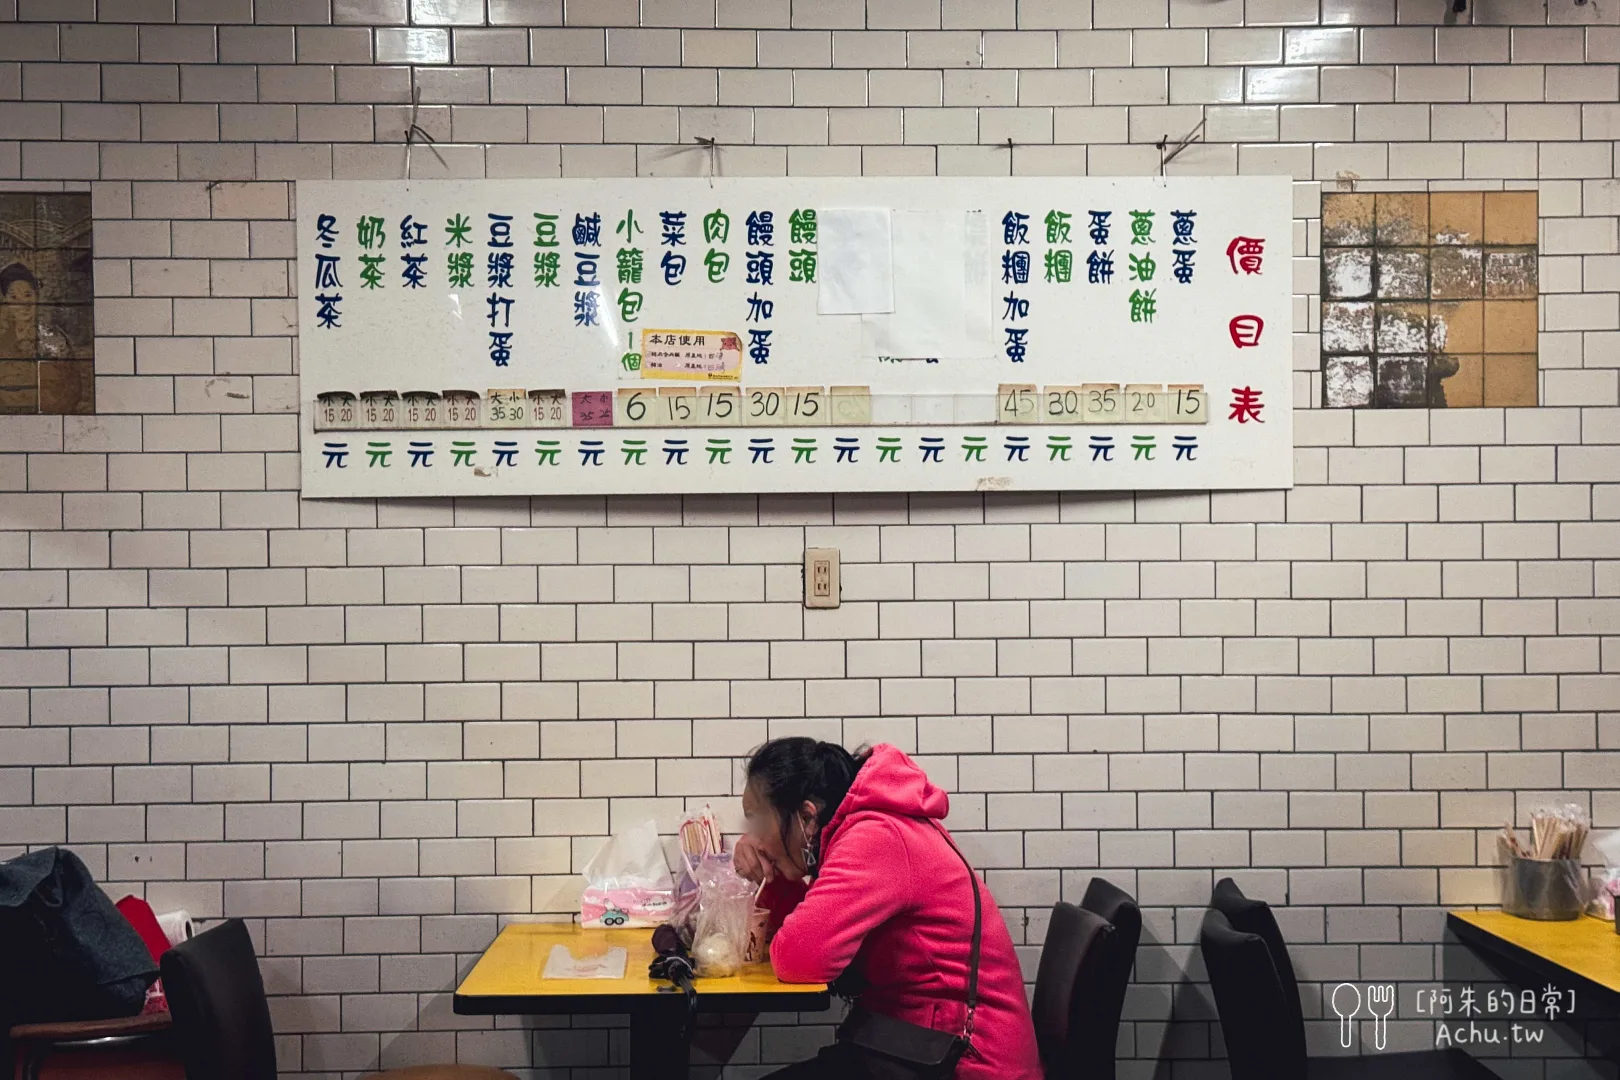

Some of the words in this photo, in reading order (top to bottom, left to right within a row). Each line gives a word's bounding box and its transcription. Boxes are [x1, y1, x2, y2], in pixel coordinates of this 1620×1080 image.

[357, 215, 385, 290] 奶茶
[400, 215, 428, 289] 紅茶
[445, 213, 474, 288] 米漿
[534, 213, 560, 287] 豆漿
[659, 211, 686, 285] 菜包
[704, 209, 729, 283] 肉包
[789, 209, 817, 283] 饅頭
[1045, 210, 1072, 282] 飯糰
[1087, 211, 1114, 284] 蛋餅
[1171, 210, 1197, 283] 蔥蛋
[315, 214, 343, 329] 冬瓜茶
[572, 212, 601, 326] 鹹豆漿
[1129, 210, 1156, 322] 蔥油餅
[487, 213, 515, 366] 豆漿打蛋
[746, 211, 774, 364] 饅頭加蛋
[1002, 211, 1030, 362] 飯糰加蛋
[650, 334, 705, 346] 本店使用
[1226, 237, 1265, 423] 價目表
[490, 392, 503, 405] 大
[509, 391, 520, 403] 小
[626, 392, 646, 421] 6
[668, 396, 691, 420] 15
[707, 393, 733, 418] 15
[751, 391, 780, 417] 30
[794, 392, 819, 416] 15
[1004, 389, 1035, 417] 45
[1048, 390, 1078, 415] 30
[1088, 388, 1116, 413] 35
[1132, 392, 1155, 412] 20
[1176, 389, 1200, 414] 15
[324, 408, 335, 422] 15
[341, 408, 352, 422] 20
[366, 408, 377, 422] 15
[383, 408, 394, 422] 20
[408, 408, 419, 422] 15
[425, 408, 436, 421] 20
[448, 408, 458, 421] 15
[465, 407, 476, 421] 20
[490, 407, 506, 421] 35
[509, 406, 524, 421] 30
[534, 407, 544, 420] 15
[550, 407, 562, 420] 20
[322, 443, 349, 468] 元
[366, 442, 392, 467] 元
[407, 442, 434, 467] 元
[450, 442, 477, 467] 元
[492, 442, 519, 466] 元
[535, 441, 561, 465] 元
[578, 441, 605, 465] 元
[621, 440, 647, 465] 元
[662, 440, 689, 464] 元
[705, 439, 732, 464] 元
[748, 439, 775, 463] 元
[792, 439, 817, 463] 元
[833, 438, 860, 462] 元
[876, 438, 902, 462] 元
[919, 438, 945, 462] 元
[962, 437, 987, 461] 元
[1004, 437, 1030, 461] 元
[1047, 436, 1072, 460] 元
[1089, 436, 1114, 461] 元
[1131, 436, 1156, 460] 元
[1173, 436, 1198, 460] 元
